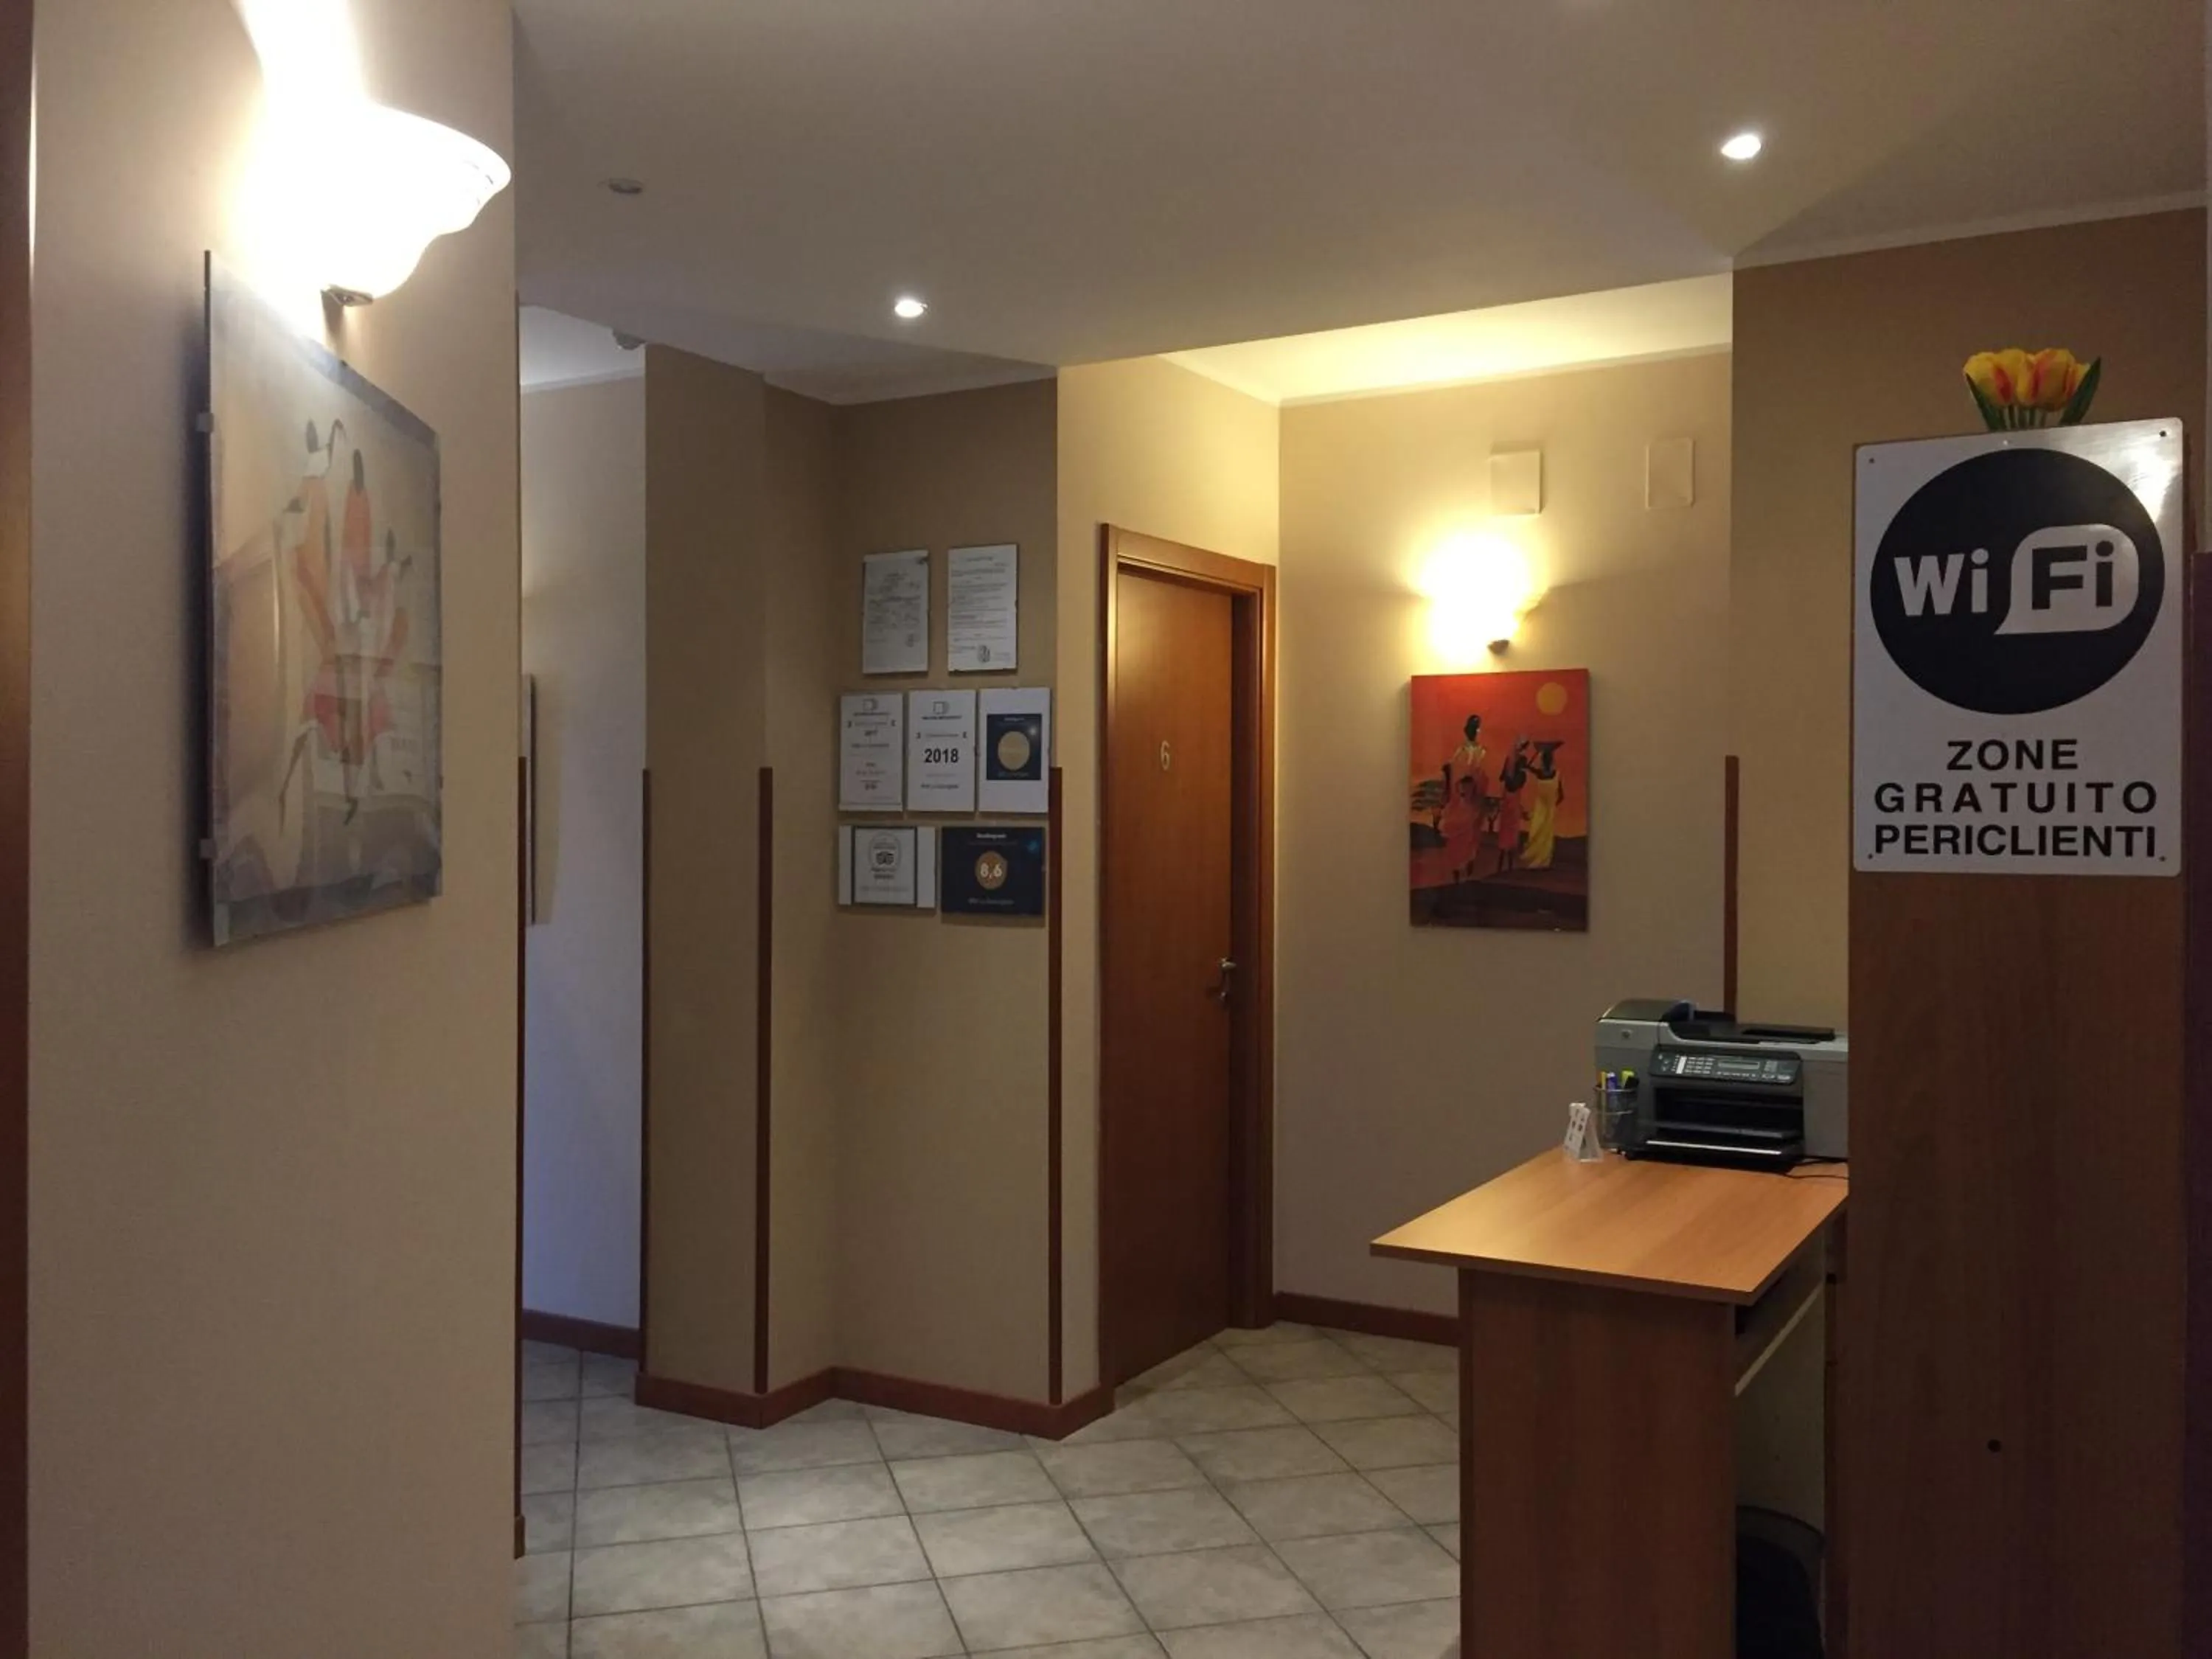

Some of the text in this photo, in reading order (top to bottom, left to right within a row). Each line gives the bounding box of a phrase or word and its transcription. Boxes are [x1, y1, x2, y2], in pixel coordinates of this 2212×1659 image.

[924, 748, 959, 764] 2018
[1161, 740, 1170, 771] 6
[1946, 738, 2079, 772] ZONE
[1874, 780, 2157, 815] GRATUITO
[1874, 824, 2156, 858] PERICLIENTI
